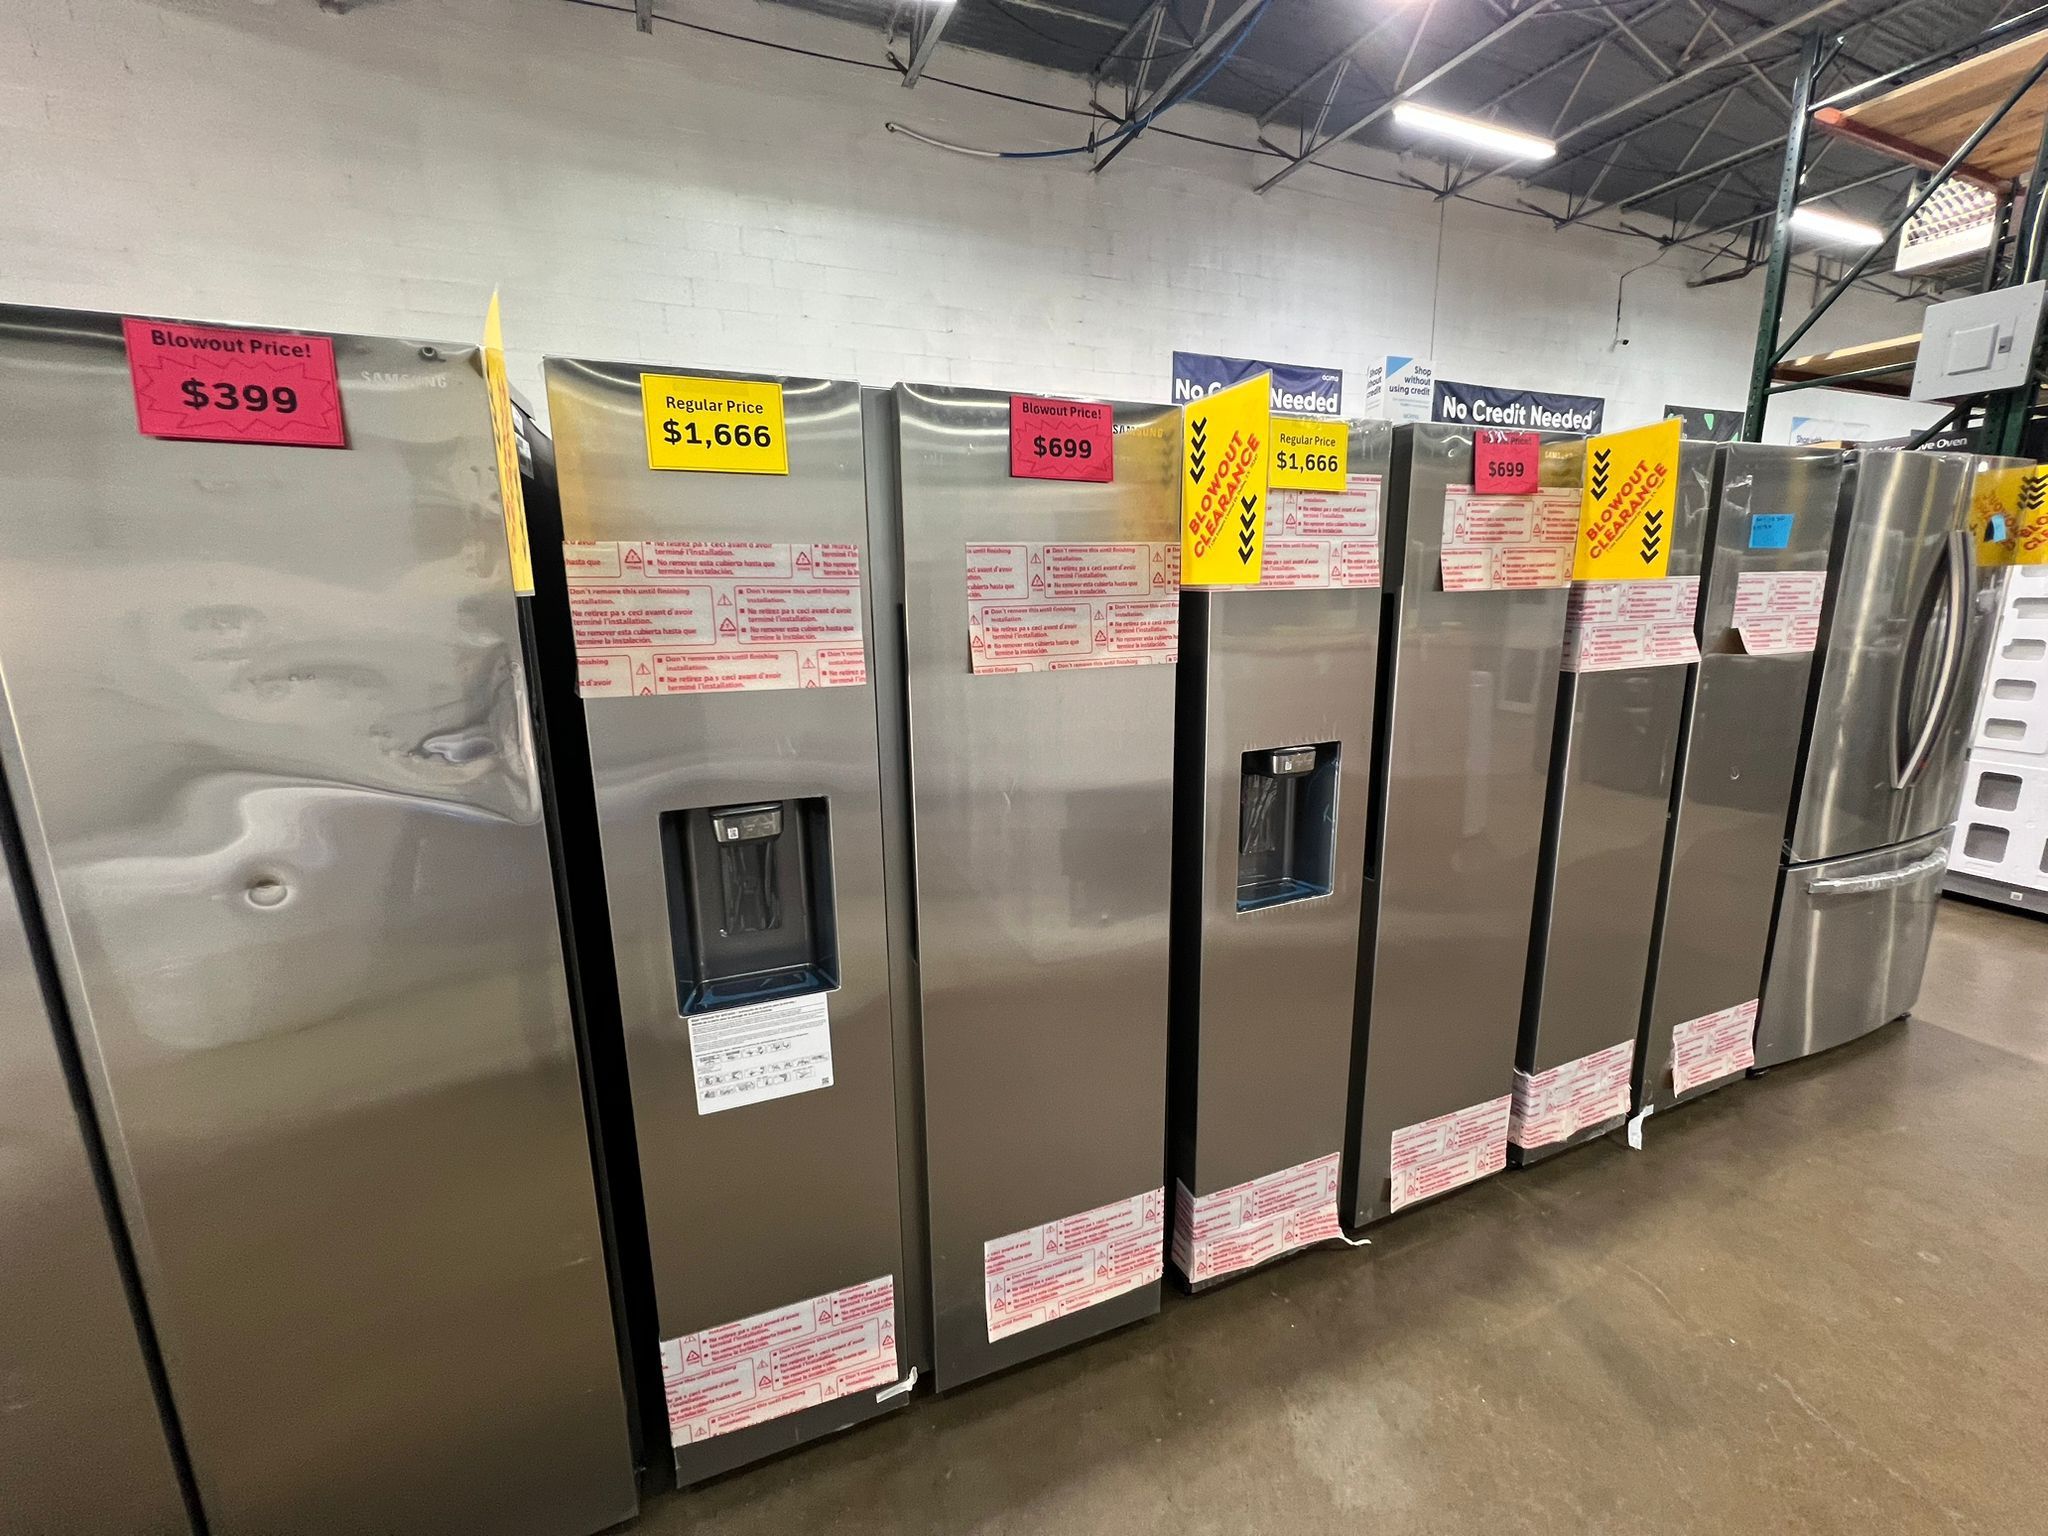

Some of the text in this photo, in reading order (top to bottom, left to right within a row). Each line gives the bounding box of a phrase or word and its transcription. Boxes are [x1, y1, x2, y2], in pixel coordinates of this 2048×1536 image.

[151, 330, 311, 357] Blowout Price!
[361, 370, 448, 389] SAMSNG
[1404, 376, 1431, 386] without
[1414, 366, 1432, 377] Shop
[181, 378, 297, 413] $399
[1176, 379, 1204, 400] No
[1270, 388, 1338, 413] Needed
[1389, 385, 1430, 395] using credit
[666, 396, 763, 414] Regular Price
[1022, 402, 1102, 420] Blowout Price!
[1443, 395, 1468, 420] No
[1472, 399, 1526, 425] Credit
[663, 418, 771, 449] $1,666
[1280, 433, 1336, 447] Regular Price
[1937, 437, 1968, 448] Oven
[1034, 435, 1092, 458] $699
[1276, 450, 1338, 472] $1,666
[1488, 461, 1525, 477] $699
[1188, 430, 1244, 536] BLOWOUT
[1193, 432, 1261, 559] CLEARANCE
[1585, 459, 1650, 542] BLOWOUT
[1589, 462, 1668, 560] CLEARANCE
